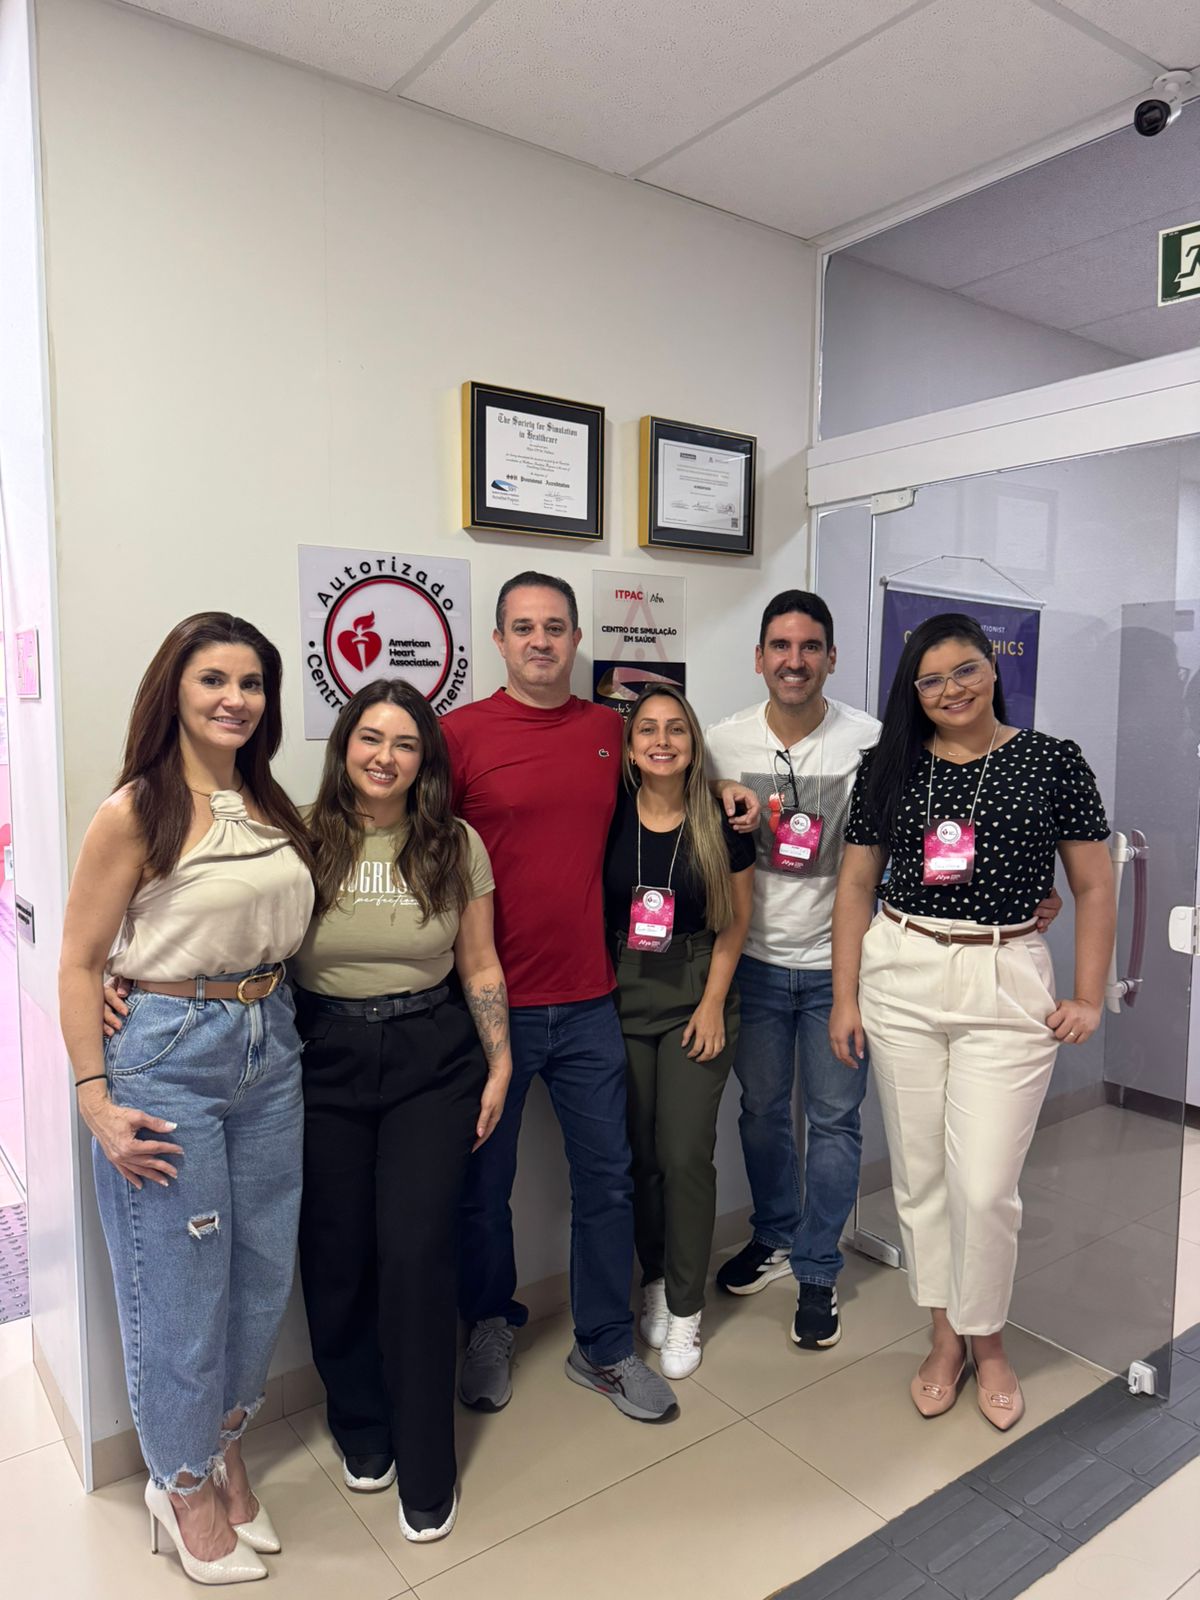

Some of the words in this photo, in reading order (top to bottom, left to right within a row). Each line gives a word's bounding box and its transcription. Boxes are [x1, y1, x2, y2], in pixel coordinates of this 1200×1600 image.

[497, 413, 511, 424] The
[512, 416, 535, 429] Society
[536, 422, 545, 431] for
[546, 422, 578, 437] Simulation
[527, 430, 558, 444] Healthcare
[317, 556, 454, 611] Autorizado
[615, 590, 644, 601] ITPAC
[602, 625, 628, 634] CENTRO
[640, 626, 677, 636] SIMULAÇÃO
[389, 638, 431, 648] American
[635, 635, 656, 644] SAÚDE
[389, 649, 415, 657] Heart
[989, 640, 1024, 656] HICS
[307, 654, 345, 713] Centr
[434, 658, 468, 715] mento
